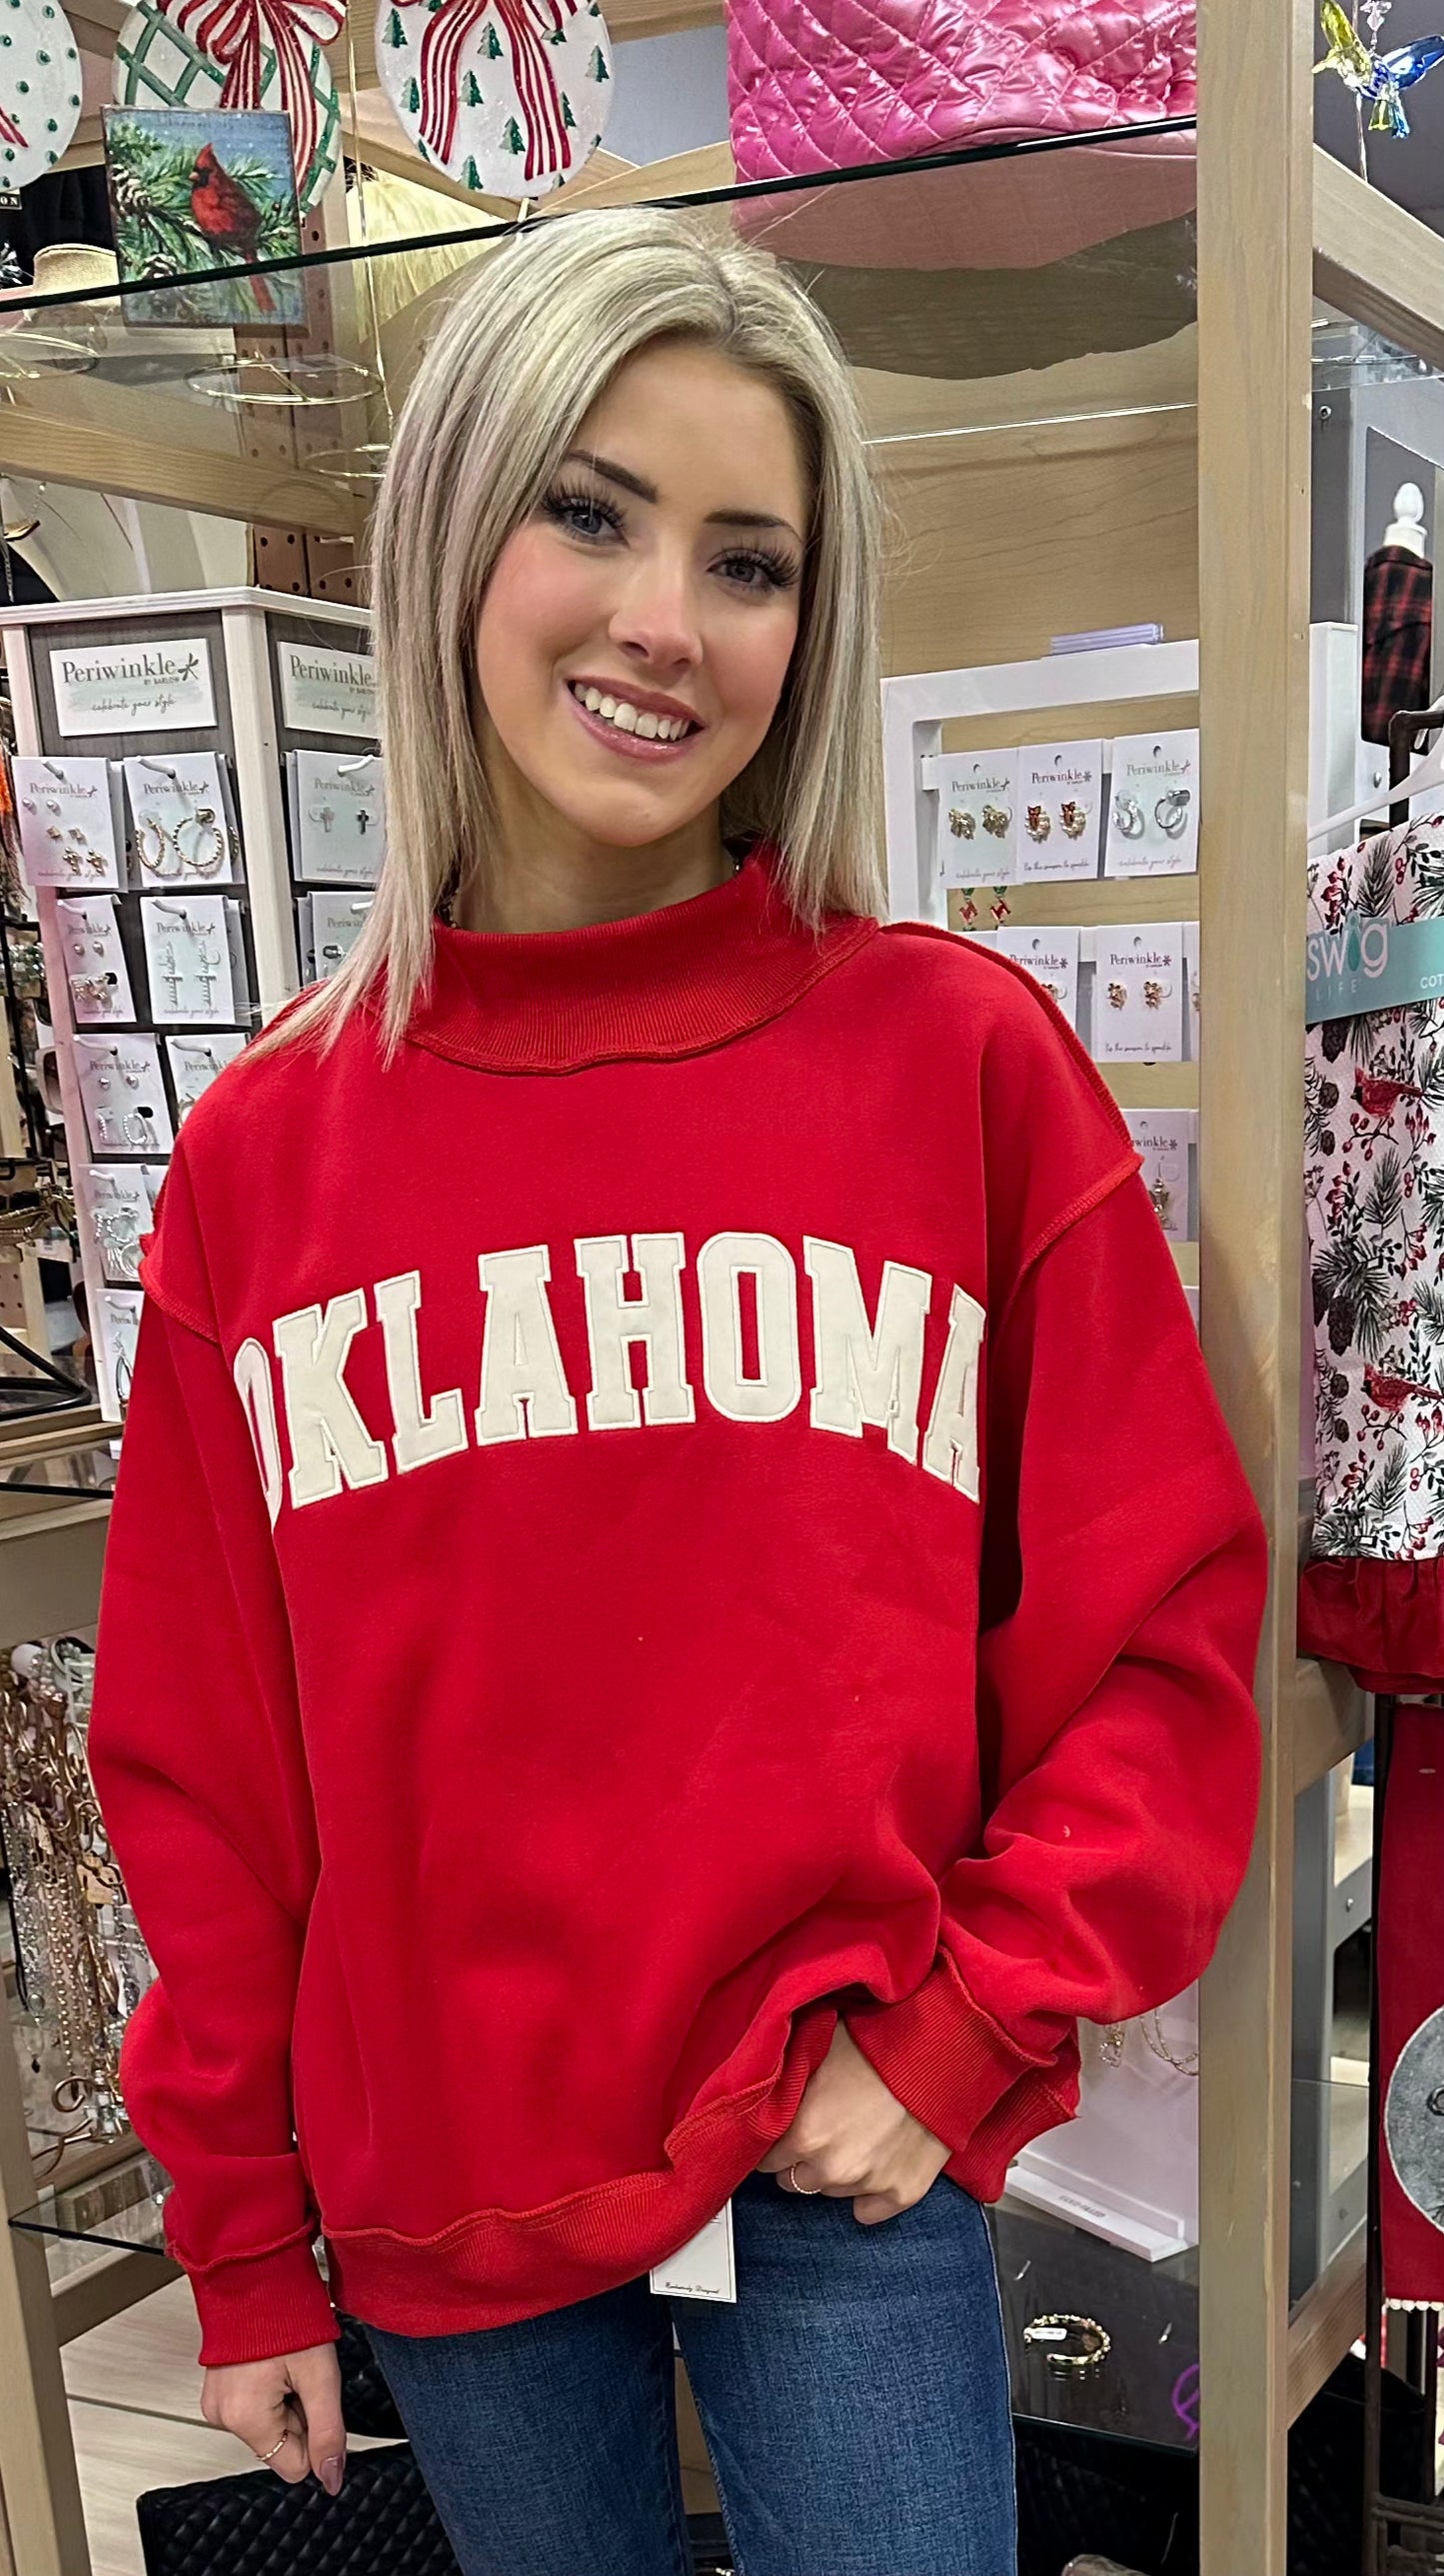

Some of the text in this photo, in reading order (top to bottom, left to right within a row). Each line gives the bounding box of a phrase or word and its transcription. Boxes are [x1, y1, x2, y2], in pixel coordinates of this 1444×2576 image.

[62, 653, 176, 684] Periwinkle
[290, 655, 372, 687] Periwinkle
[132, 701, 151, 717] your
[154, 694, 177, 714] style
[1031, 769, 1082, 785] Periwinkle
[1126, 760, 1181, 777] Periwinkle
[951, 777, 1000, 793] Periwinkle
[1110, 952, 1162, 966] Periwinkle
[231, 1231, 986, 1533] OKLAHOMA
